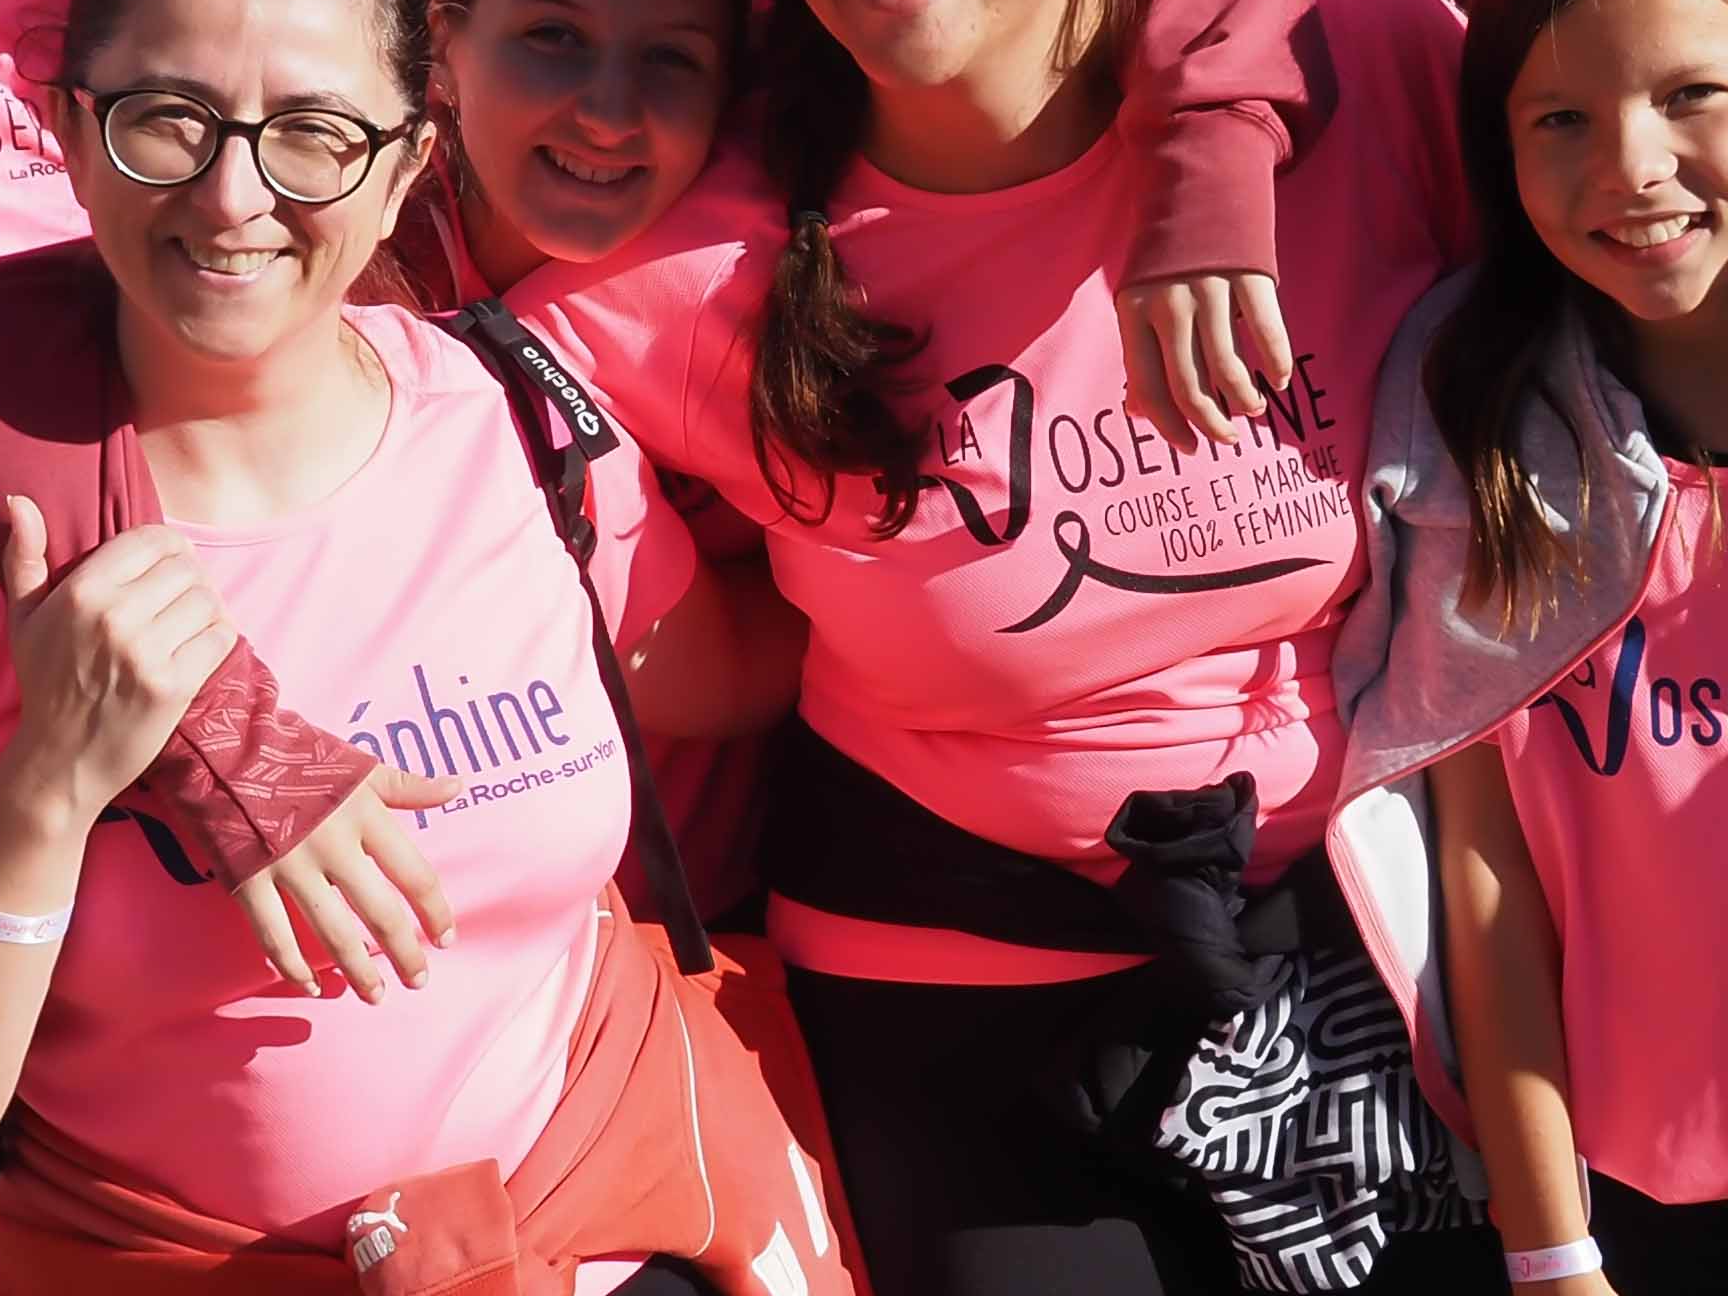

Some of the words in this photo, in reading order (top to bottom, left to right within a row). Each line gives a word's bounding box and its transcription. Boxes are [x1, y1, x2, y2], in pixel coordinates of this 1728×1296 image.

[936, 410, 983, 467] LA
[1104, 484, 1194, 536] COURSE
[1210, 476, 1239, 512] ET
[1251, 444, 1342, 503] MARCHE
[1160, 517, 1224, 567] 100%
[1233, 480, 1352, 548] FÉMININE
[469, 738, 617, 806] Roche-sur-Yon
